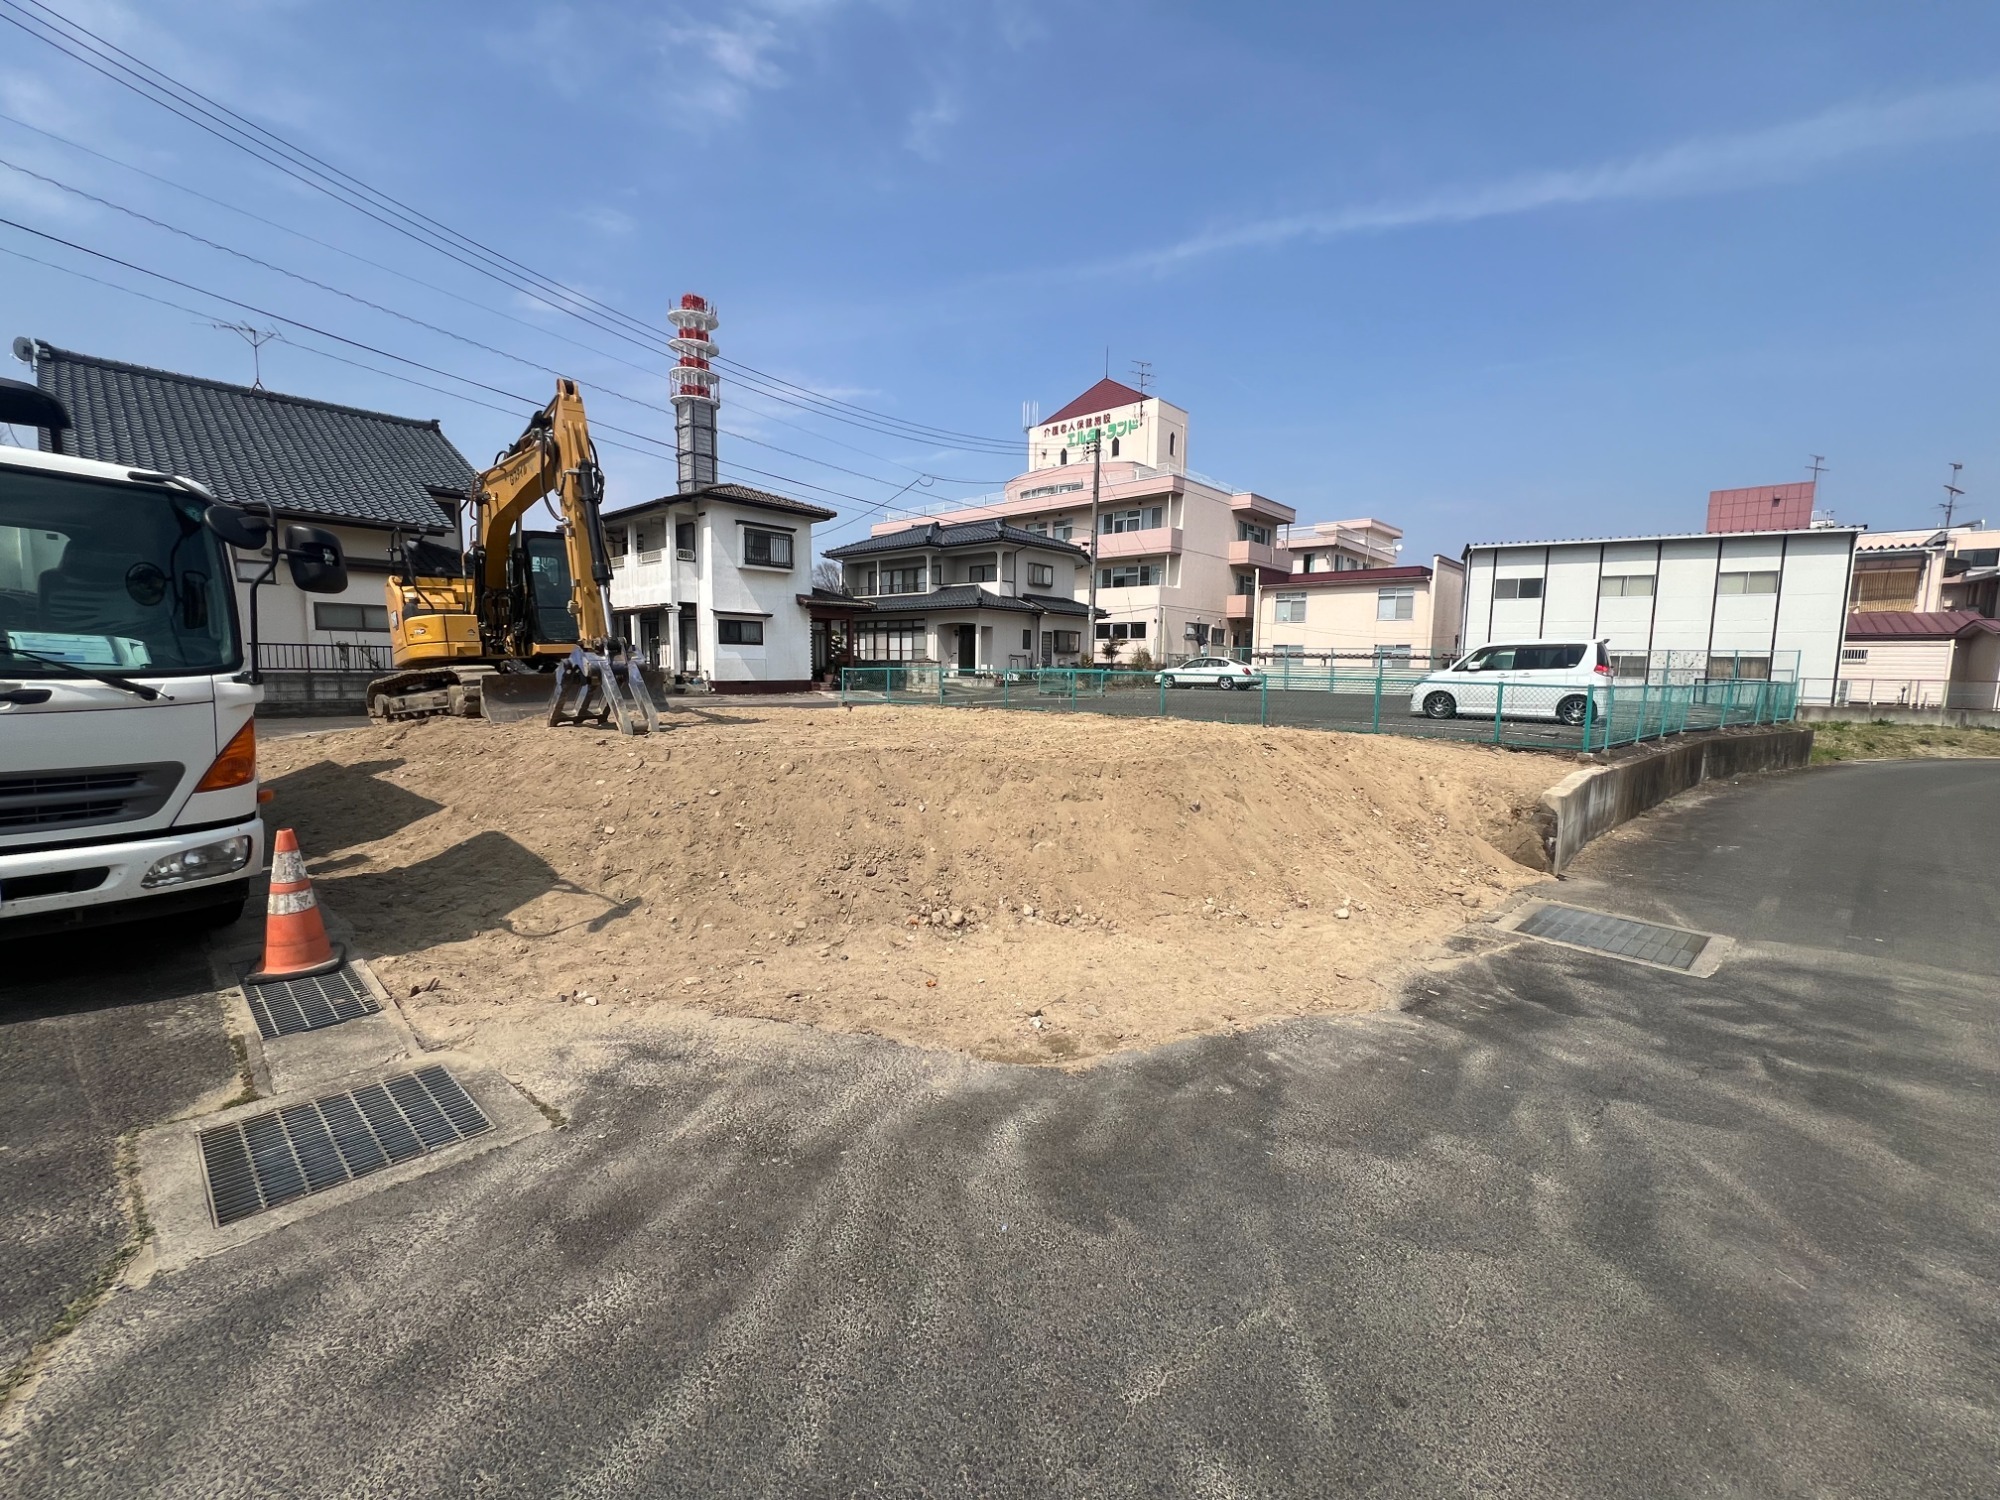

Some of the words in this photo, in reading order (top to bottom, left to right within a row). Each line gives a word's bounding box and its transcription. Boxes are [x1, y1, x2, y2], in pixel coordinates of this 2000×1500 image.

[1044, 413, 1111, 438] 介護老人保健施設
